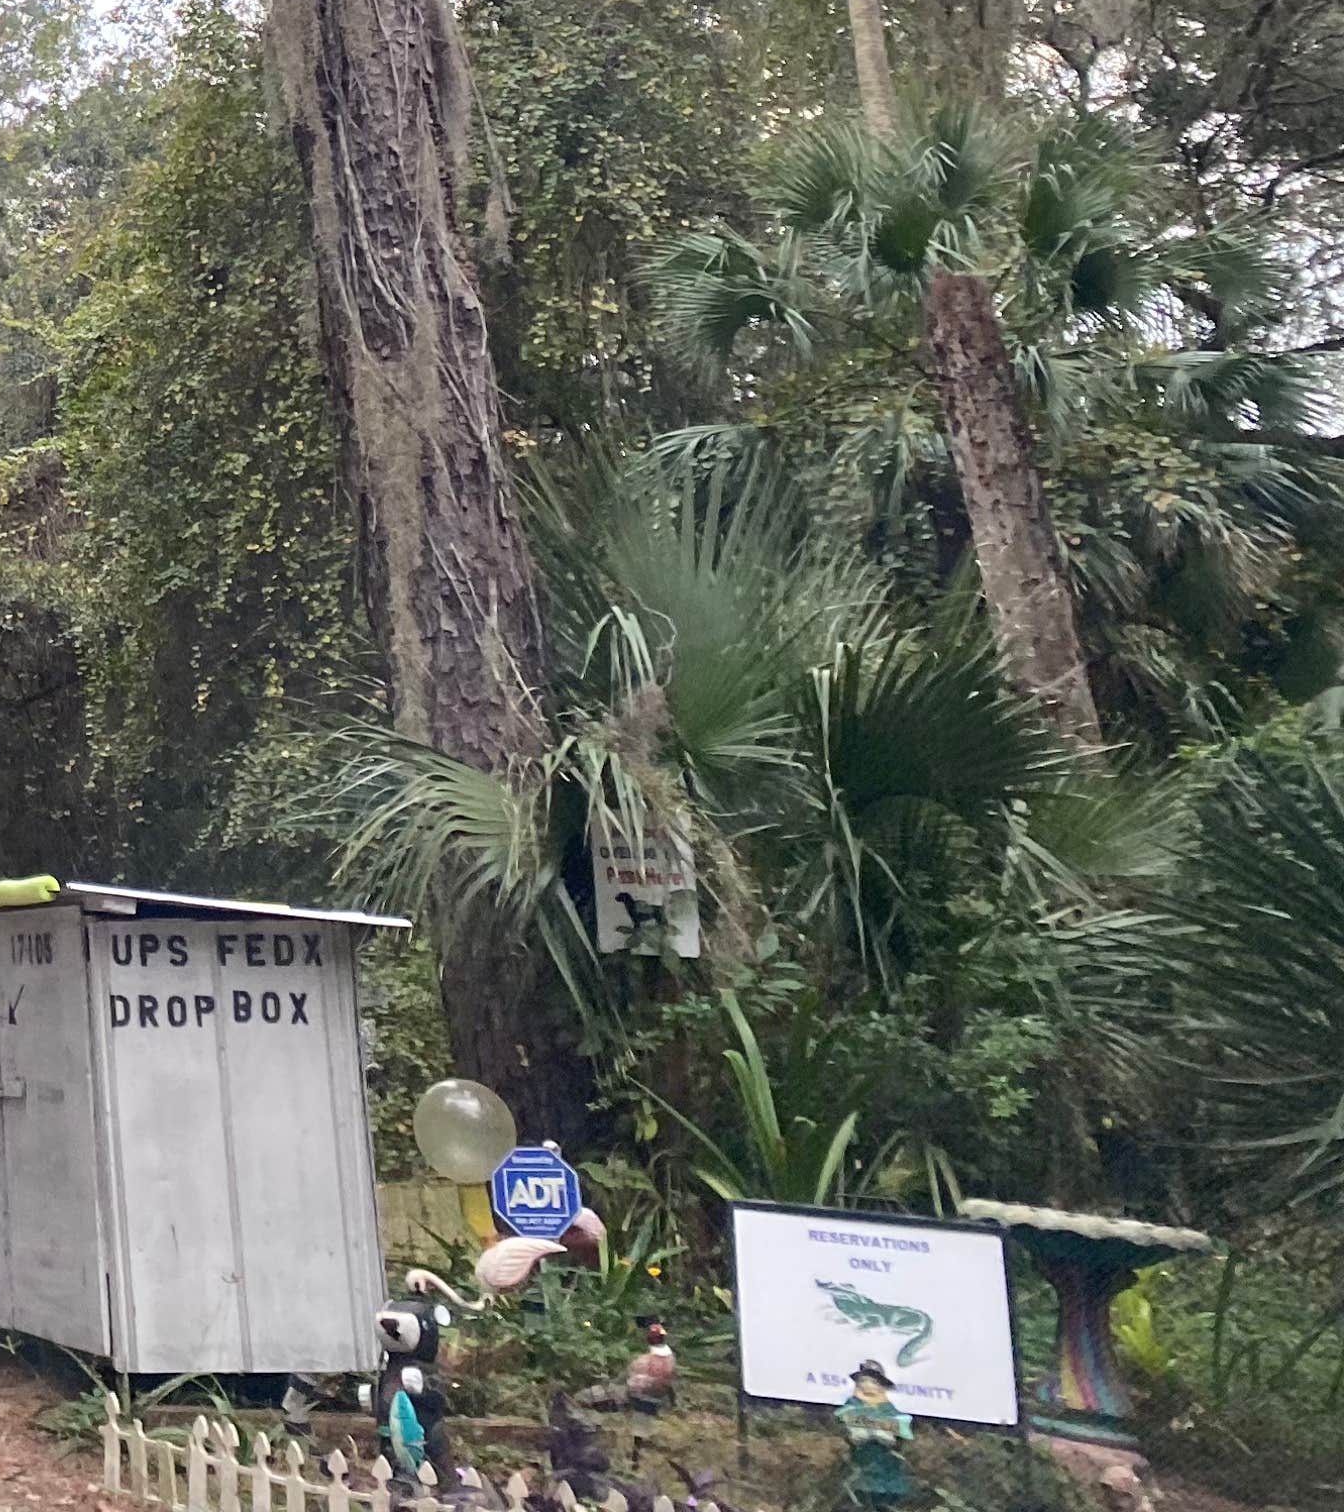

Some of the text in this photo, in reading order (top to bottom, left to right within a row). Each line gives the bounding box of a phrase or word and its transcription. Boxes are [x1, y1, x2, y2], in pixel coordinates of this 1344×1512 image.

[112, 933, 323, 967] UPS FEDX
[109, 990, 309, 1028] DROP BOX
[509, 1177, 565, 1208] ADT
[808, 1229, 931, 1253] RESERVATIONS
[849, 1258, 892, 1273] ONLY
[806, 1372, 817, 1384] A
[894, 1383, 956, 1400] MUNITY
